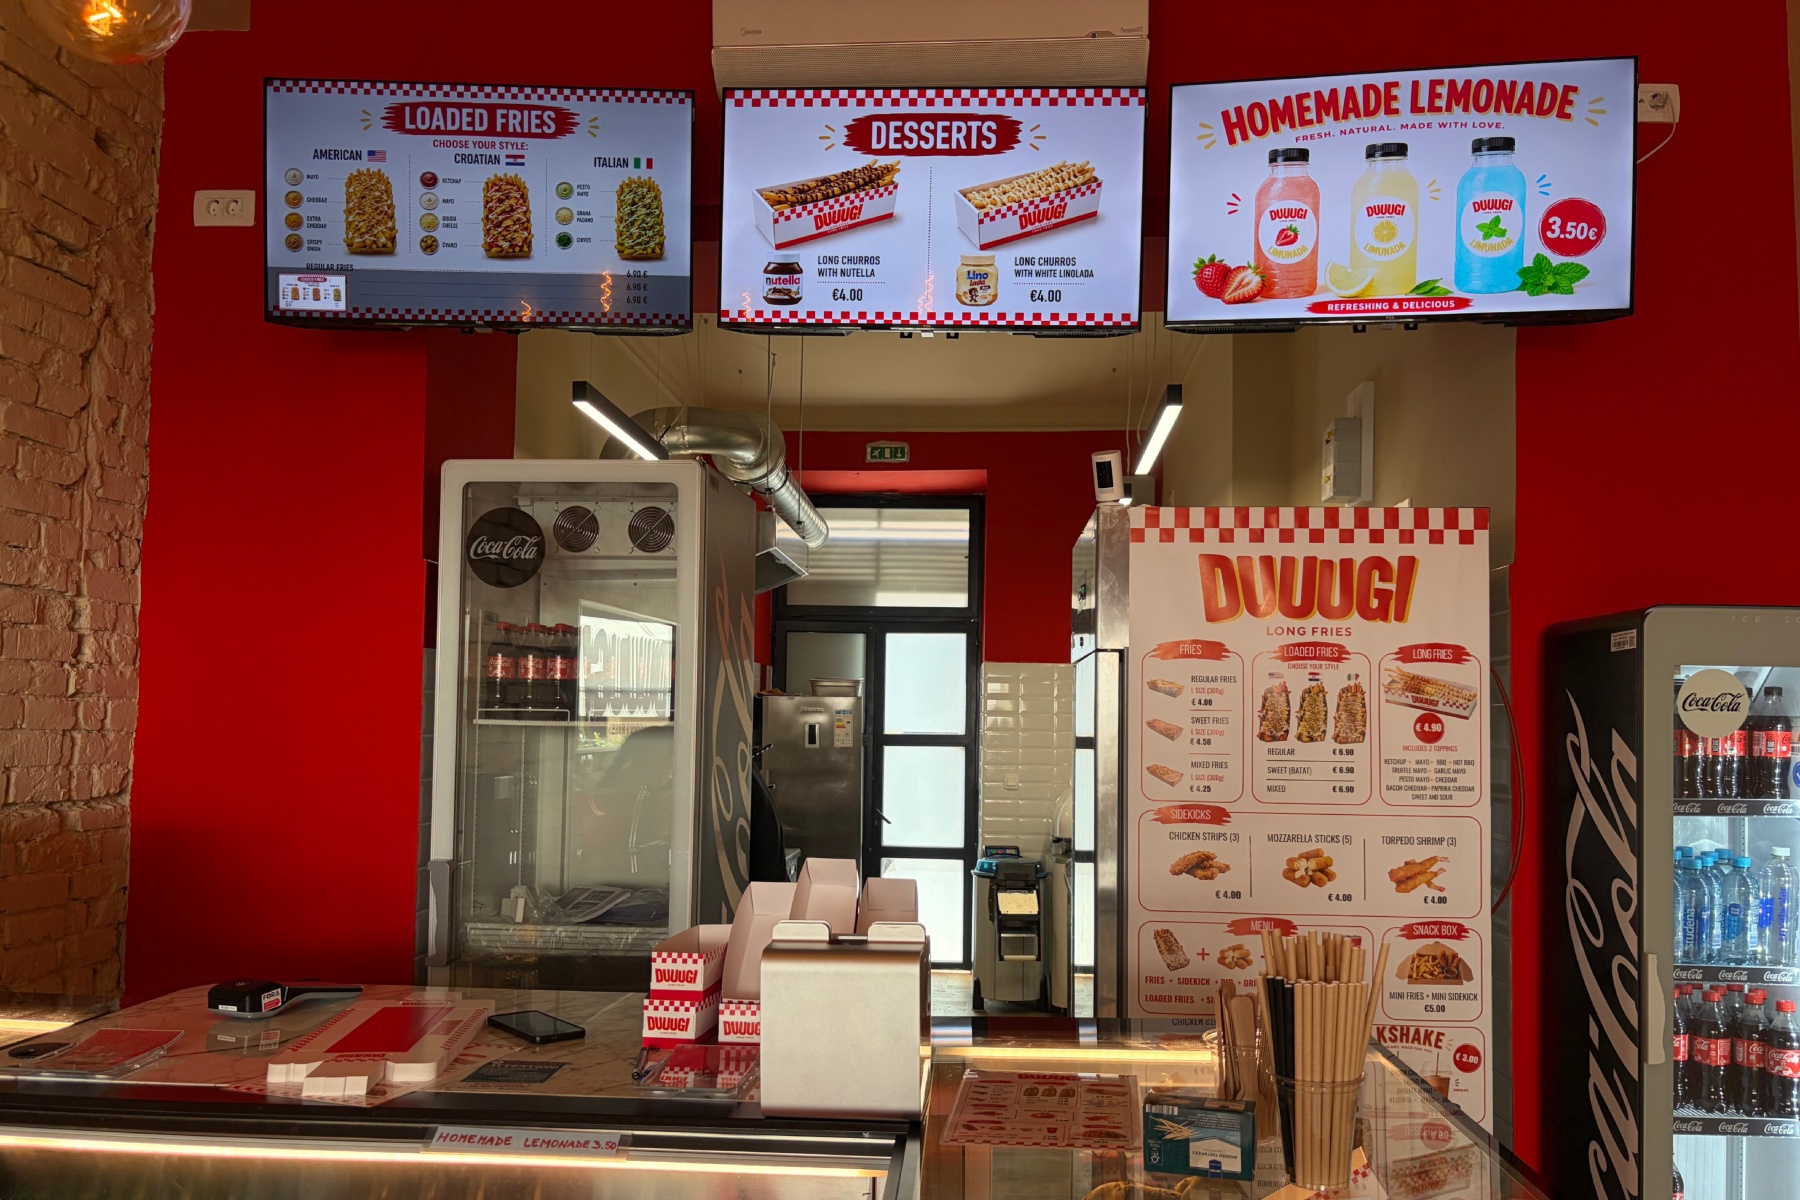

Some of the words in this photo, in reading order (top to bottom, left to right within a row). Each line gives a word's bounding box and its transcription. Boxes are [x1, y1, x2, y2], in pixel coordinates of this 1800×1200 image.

[1220, 81, 1400, 148] HOMEMADE
[1410, 79, 1579, 122] LEMONADE
[404, 106, 488, 132] LOADED
[496, 108, 556, 134] FRIES
[871, 120, 997, 150] DESSERTS
[1295, 131, 1335, 143] FRESH.
[1339, 125, 1396, 137] NATURAL.
[1400, 121, 1433, 131] MADE
[1438, 121, 1468, 130] WITH
[1472, 121, 1505, 131] LOVE.
[432, 139, 470, 149] CHOOSE
[471, 140, 497, 150] YOUR
[498, 141, 529, 151] STYLE:
[313, 149, 362, 162] AMERICAN
[454, 152, 501, 165] CROATIAN
[593, 156, 629, 169] ITALIAN
[306, 215, 322, 223] EXTRA
[1546, 216, 1599, 241] 3.50€
[1363, 240, 1406, 257] LIMUNADA
[1469, 236, 1514, 253] LIMUNADA
[1267, 244, 1308, 260] LIMUNADA
[817, 255, 840, 266] LONG
[841, 255, 880, 266] CHURROS
[1014, 256, 1036, 267] LONG
[1037, 256, 1077, 267] CHURROS
[306, 262, 335, 272] REGULAR
[336, 263, 354, 273] FRIES
[817, 267, 838, 278] WITH
[840, 267, 876, 278] NUTELLA
[626, 270, 642, 279] 6.90
[765, 274, 801, 286] nutella
[966, 270, 989, 282] Lino
[1014, 268, 1034, 279] WITH
[1034, 269, 1058, 279] WHITE
[1059, 269, 1095, 280] LINOLADA
[626, 283, 642, 292] 6.90
[626, 296, 642, 304] 6.90
[832, 287, 863, 303] €4.00
[1030, 289, 1062, 304] €4.00
[1327, 302, 1389, 312] REFRESHING
[1392, 302, 1399, 310] &
[1402, 300, 1456, 310] DELICIOUS
[469, 535, 542, 560] Coca-Cola
[1266, 626, 1306, 637] LONG
[1311, 626, 1353, 637] FRIES
[1179, 644, 1202, 655] FRIES
[1284, 645, 1315, 657] LOADED
[1316, 646, 1339, 658] FRIES
[1412, 648, 1432, 660] LONG
[1432, 649, 1453, 660] FRIES
[1287, 662, 1309, 671] CHOOSE
[1310, 662, 1324, 671] YOUR
[1324, 663, 1340, 672] STYLE
[1190, 675, 1219, 685] REGULAR
[1220, 675, 1238, 685] FRIES
[1197, 698, 1213, 707] 4.00
[1682, 692, 1745, 713] Coca-Cola
[1190, 716, 1211, 726] SWEET
[1212, 716, 1230, 726] FRIES
[1423, 723, 1442, 733] 4.90
[1196, 738, 1212, 747] 4.50
[1267, 747, 1295, 757] REGULAR
[1338, 748, 1354, 757] 6.90
[1402, 744, 1428, 753] INCLUDES
[1432, 745, 1458, 754] TOPPINGS
[1190, 761, 1210, 770] MIXED
[1211, 761, 1229, 770] FRIES
[1384, 758, 1407, 767] KETCHUP
[1415, 758, 1430, 767] MAYO
[1436, 759, 1447, 768] BBQ
[1452, 759, 1463, 767] HOT
[1464, 759, 1475, 768] BBQ
[1267, 766, 1288, 775] SWEET
[1288, 766, 1312, 777] (BATAT)
[1338, 766, 1355, 775] 6.90
[1391, 766, 1412, 775] TRUFFLE
[1412, 767, 1428, 775] MAYO
[1434, 768, 1451, 776] GARLIC
[1452, 768, 1467, 776] MAYO
[1398, 776, 1415, 784] PESTO
[1415, 776, 1430, 784] MAYO
[1434, 776, 1458, 785] CHEDDAR
[1196, 785, 1212, 794] 4.25
[1266, 785, 1287, 794] MIXED
[1338, 785, 1355, 794] 6.90
[1386, 784, 1403, 792] BACON
[1403, 784, 1428, 793] CHEDDAR
[1431, 785, 1451, 794] PAPRIKA
[1452, 786, 1475, 794] CHEDDAR
[1411, 793, 1428, 802] SWEET
[1428, 794, 1439, 802] AND
[1439, 794, 1453, 802] SOUR
[1170, 808, 1211, 820] SIDEKICKS
[1169, 831, 1200, 842] CHICKEN
[1202, 832, 1228, 843] STRIPS
[1230, 832, 1240, 844] (3)
[1267, 833, 1312, 844] MOZZARELLA
[1314, 834, 1341, 845] STICKS
[1342, 834, 1353, 847] (5)
[1381, 835, 1415, 846] TORPEDO
[1416, 836, 1445, 847] SHRIMP
[1446, 836, 1457, 848] (3)
[1222, 890, 1242, 900] 4.00
[1334, 893, 1353, 902] 4.00
[1430, 896, 1448, 905] 4.00
[1250, 920, 1274, 932] MENU
[1412, 924, 1441, 937] SNACK
[1442, 925, 1458, 937] BOX
[1684, 907, 1697, 951] studena
[1145, 975, 1165, 986] FRIES
[1177, 976, 1211, 987] SIDEKICK
[1145, 994, 1173, 1004] LOADED
[1174, 995, 1195, 1005] FRIES
[1389, 991, 1405, 1001] MINI
[1406, 992, 1425, 1002] FRIES
[1431, 992, 1447, 1002] MINI
[1448, 992, 1479, 1003] SIDEKICK
[1424, 1004, 1446, 1014] €5.00
[1376, 1026, 1446, 1051] KSHAKE
[1462, 1053, 1479, 1065] 3.00
[436, 1132, 513, 1146] HOMEMADE
[523, 1137, 591, 1150] LEMONADE
[591, 1140, 617, 1151] 3.50
